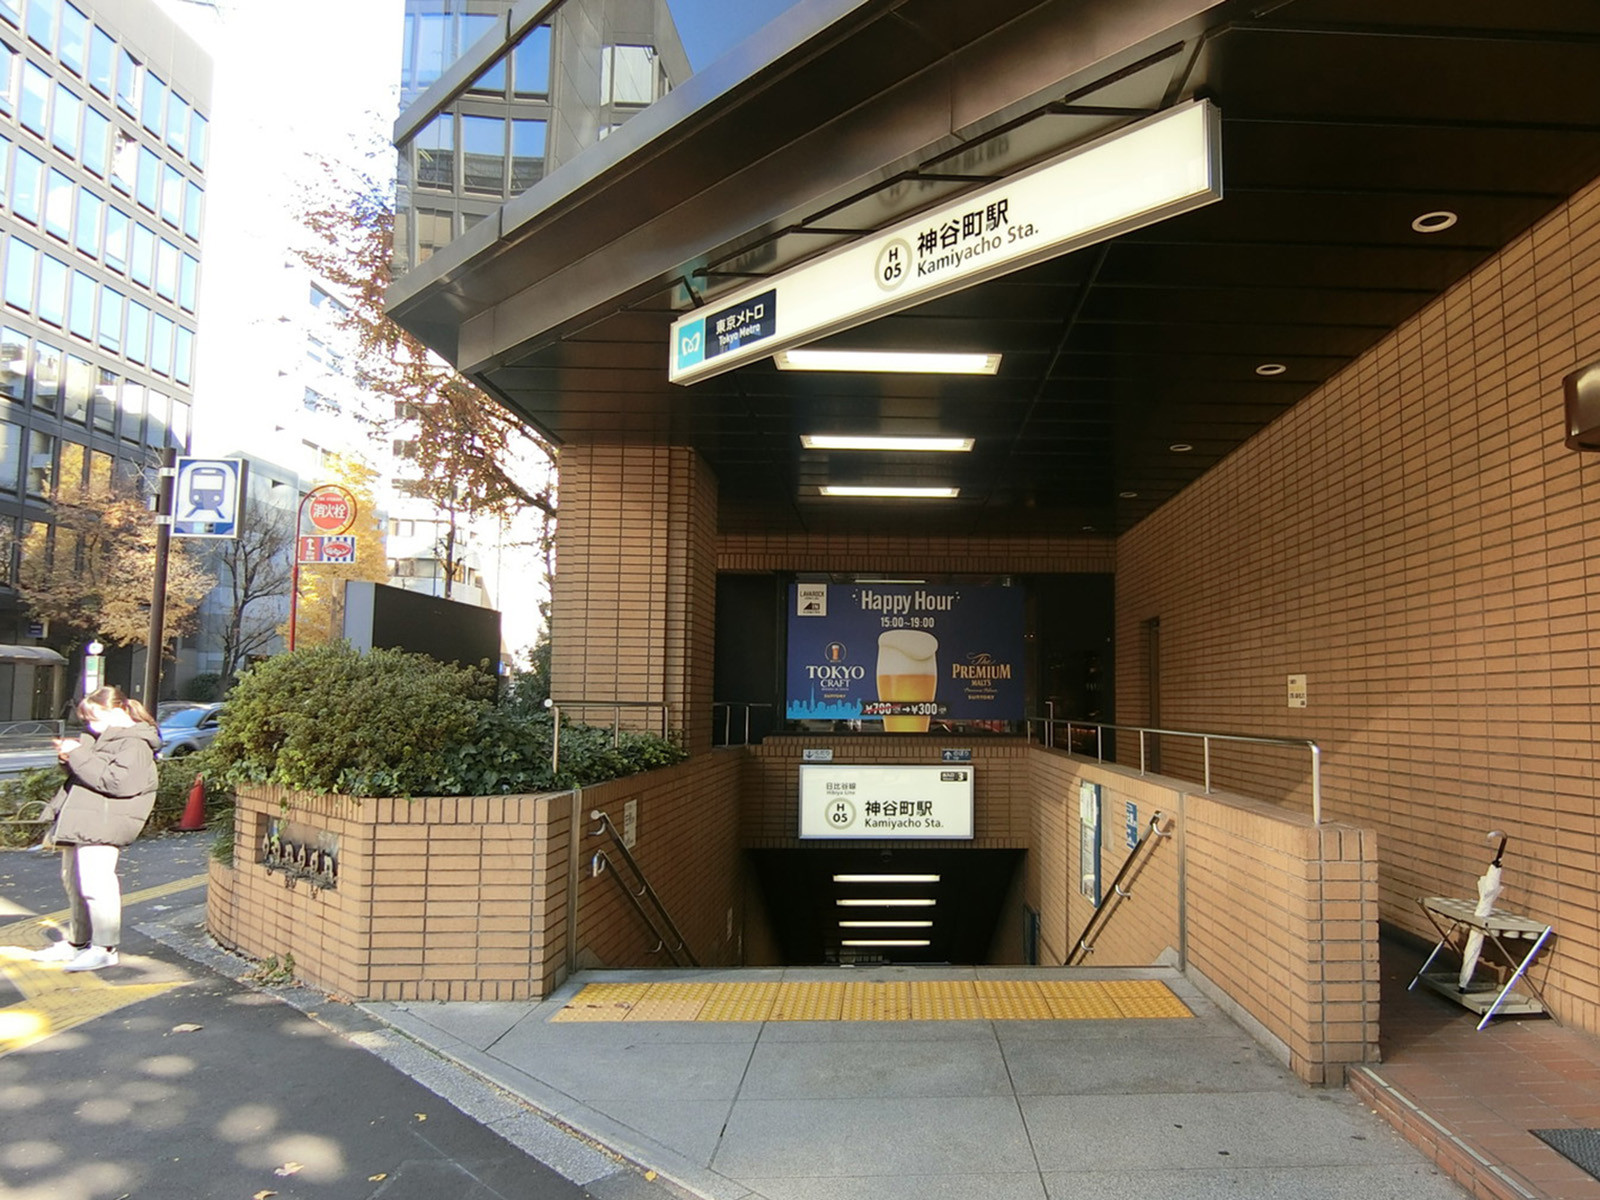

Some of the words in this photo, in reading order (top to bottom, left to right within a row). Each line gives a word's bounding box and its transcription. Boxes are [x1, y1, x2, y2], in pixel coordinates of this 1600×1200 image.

[917, 199, 1009, 258] 神谷町駅
[889, 248, 899, 263] H
[917, 233, 1002, 278] Kamiyacho
[1008, 220, 1039, 245] Sta.
[884, 264, 902, 281] 05
[716, 303, 764, 335] 東京メトロ
[718, 331, 739, 346] Tokyo
[739, 323, 761, 339] Metro
[313, 504, 346, 518] 消火栓
[861, 590, 912, 614] Happy
[915, 590, 954, 611] Hour
[806, 666, 865, 680] TOKYO
[952, 663, 1011, 679] PREMIUM
[820, 679, 851, 688] CRAFT
[865, 702, 892, 715] ¥700
[911, 702, 938, 715] ¥300
[957, 772, 964, 781] 3
[836, 803, 845, 812] H
[865, 800, 933, 816] 神谷町駅
[832, 813, 848, 823] 05
[865, 818, 922, 830] Kamiyacho
[925, 818, 944, 828] Sta.
